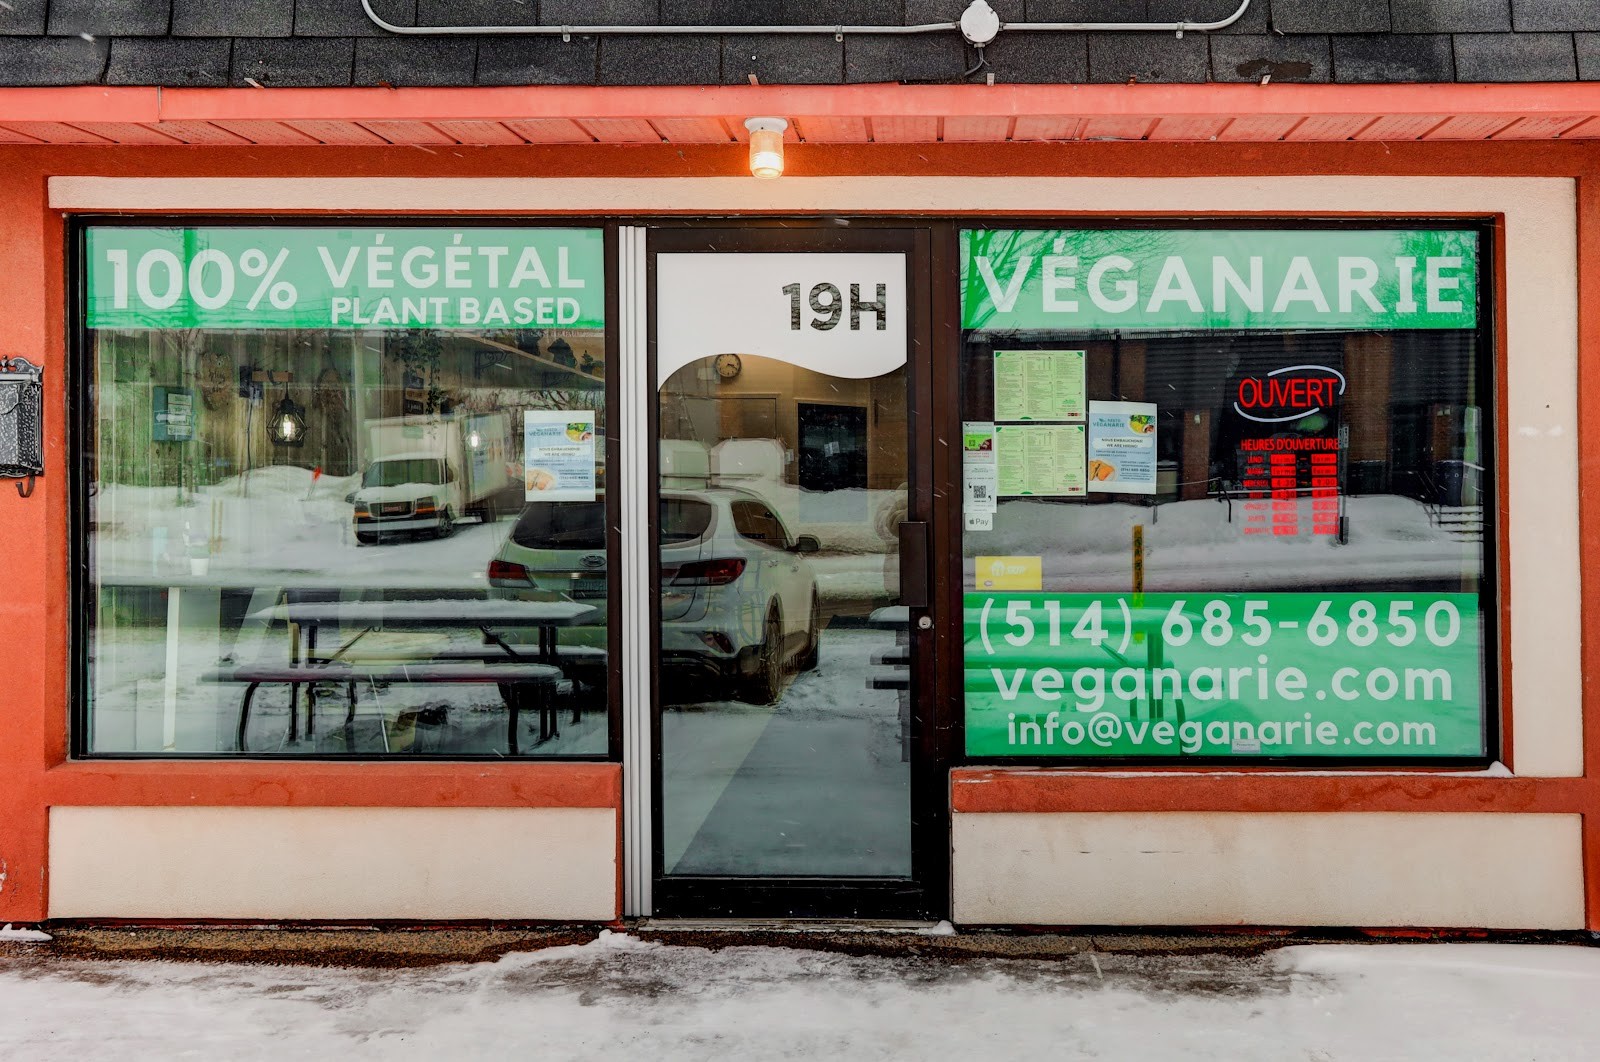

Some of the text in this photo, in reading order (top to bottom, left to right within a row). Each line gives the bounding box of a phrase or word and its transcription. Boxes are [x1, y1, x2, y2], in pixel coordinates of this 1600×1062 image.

[107, 247, 298, 311] 100%
[317, 234, 585, 288] VÉGÉTAL
[974, 238, 1463, 313] VÉGANARIE
[332, 296, 581, 325] PLANT BASED
[782, 282, 886, 331] 19H
[1238, 378, 1338, 408] OUVERT
[1241, 437, 1339, 451] HEURES D'OUVERTURE
[975, 518, 989, 526] Pay
[980, 597, 1461, 654] (514) 685-6850
[991, 654, 1452, 712] veganarie.com
[1008, 712, 1437, 753] info@veganarie.com
